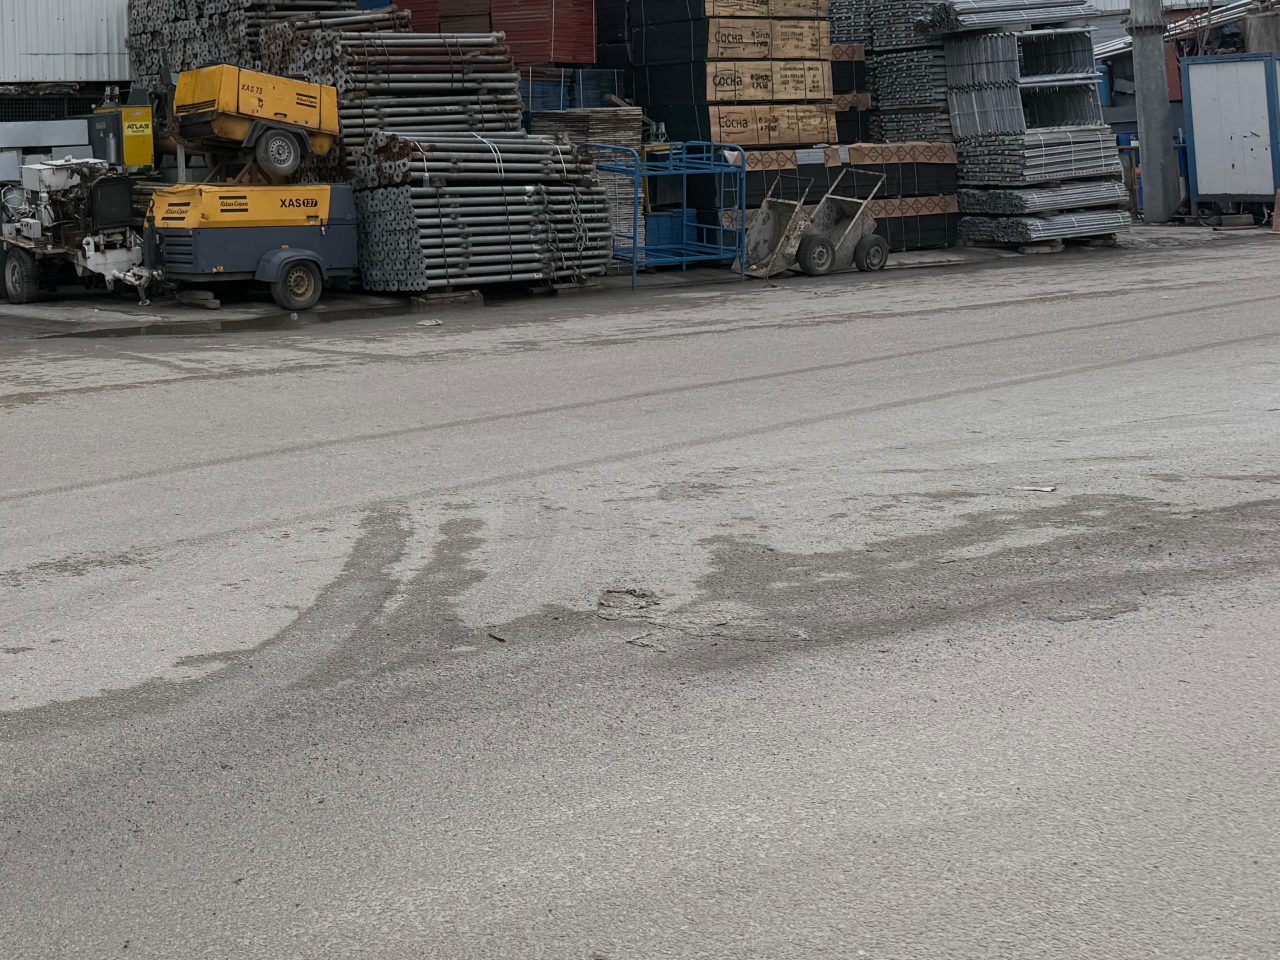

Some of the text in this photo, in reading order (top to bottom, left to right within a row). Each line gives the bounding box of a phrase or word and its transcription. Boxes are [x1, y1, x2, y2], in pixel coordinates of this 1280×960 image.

[241, 83, 254, 93] XAS
[280, 199, 318, 208] XAS 137
